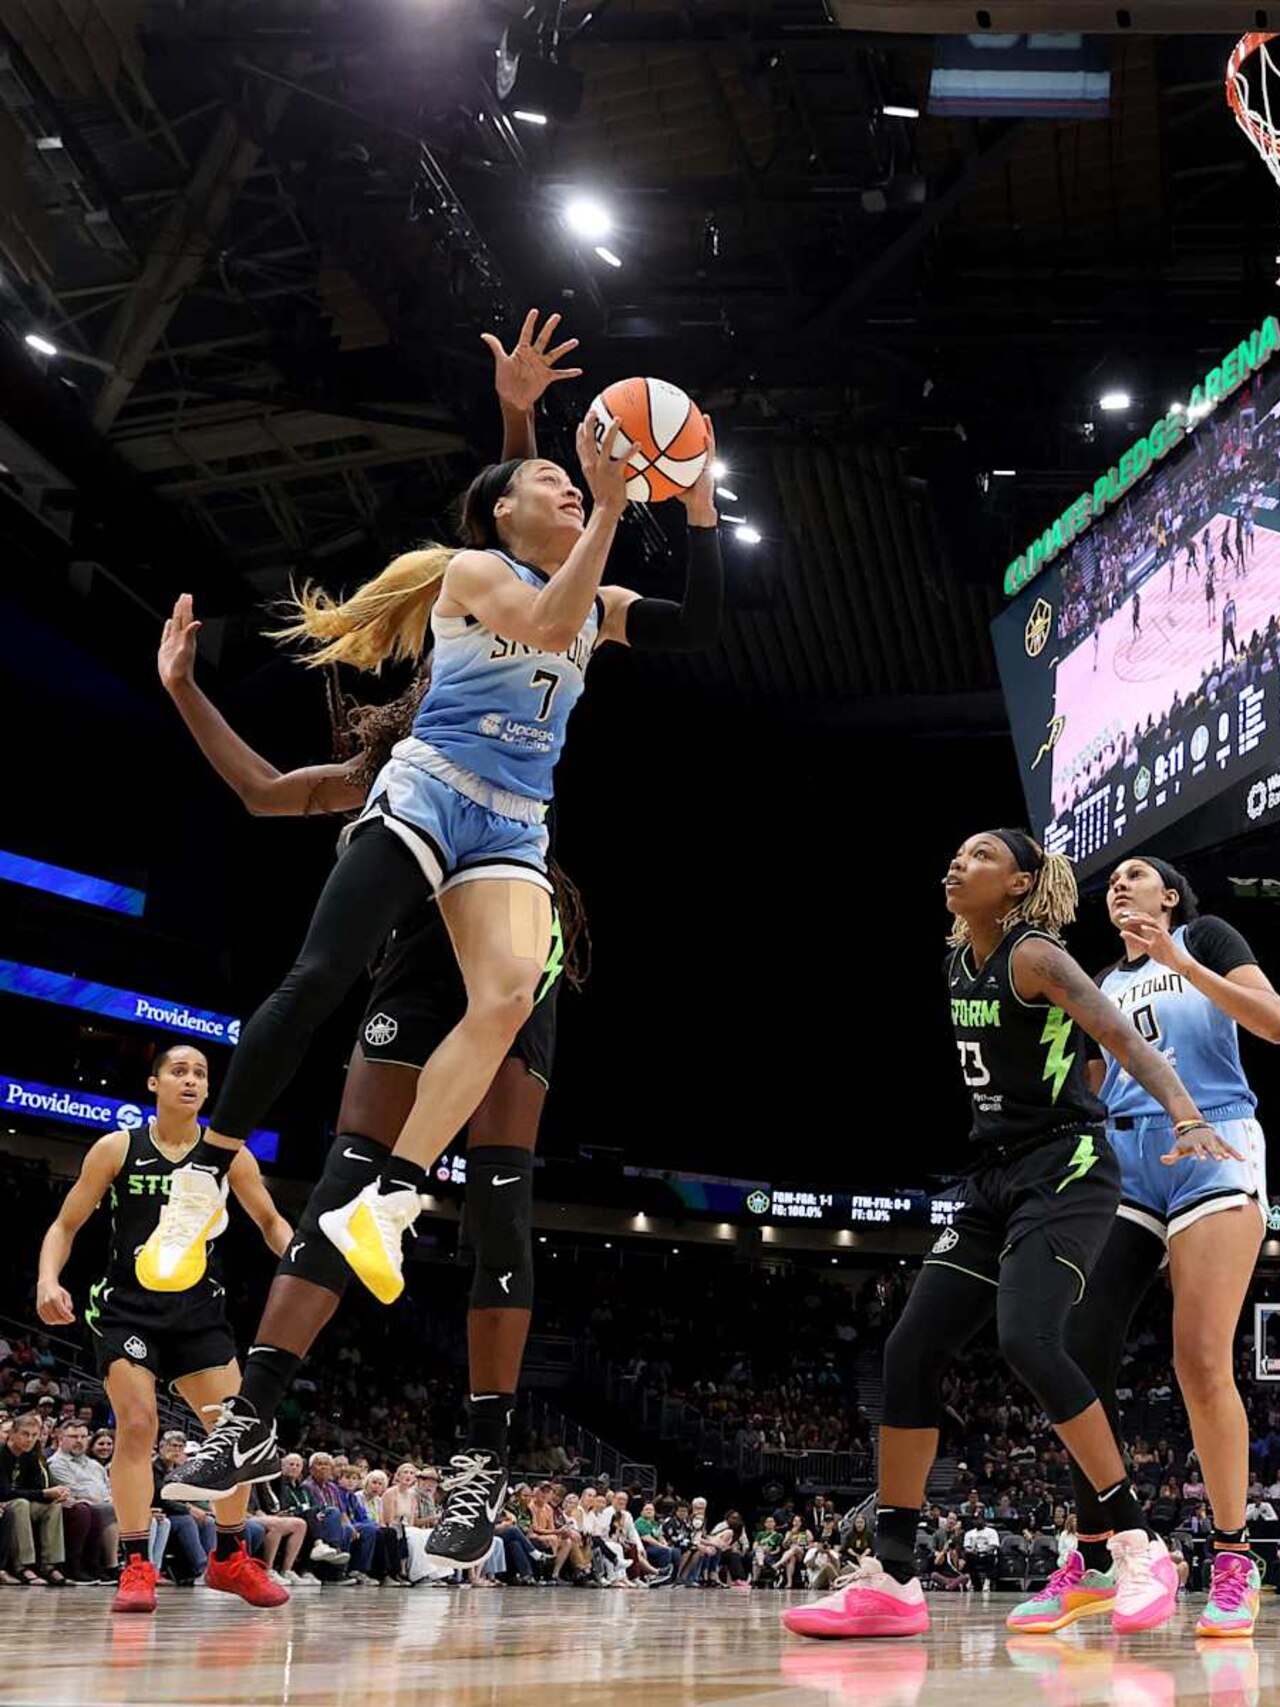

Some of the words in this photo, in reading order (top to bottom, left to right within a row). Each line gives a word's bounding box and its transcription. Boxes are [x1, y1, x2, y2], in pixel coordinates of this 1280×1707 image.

[1003, 491, 1092, 595] CLIMATE
[1093, 407, 1187, 516] PLEDGE
[531, 668, 561, 721] 7
[1218, 712, 1230, 742] 0
[1154, 741, 1184, 786] 9:11
[1116, 784, 1125, 812] 2
[136, 1000, 223, 1037] Providence
[7, 1083, 111, 1122] Providence
